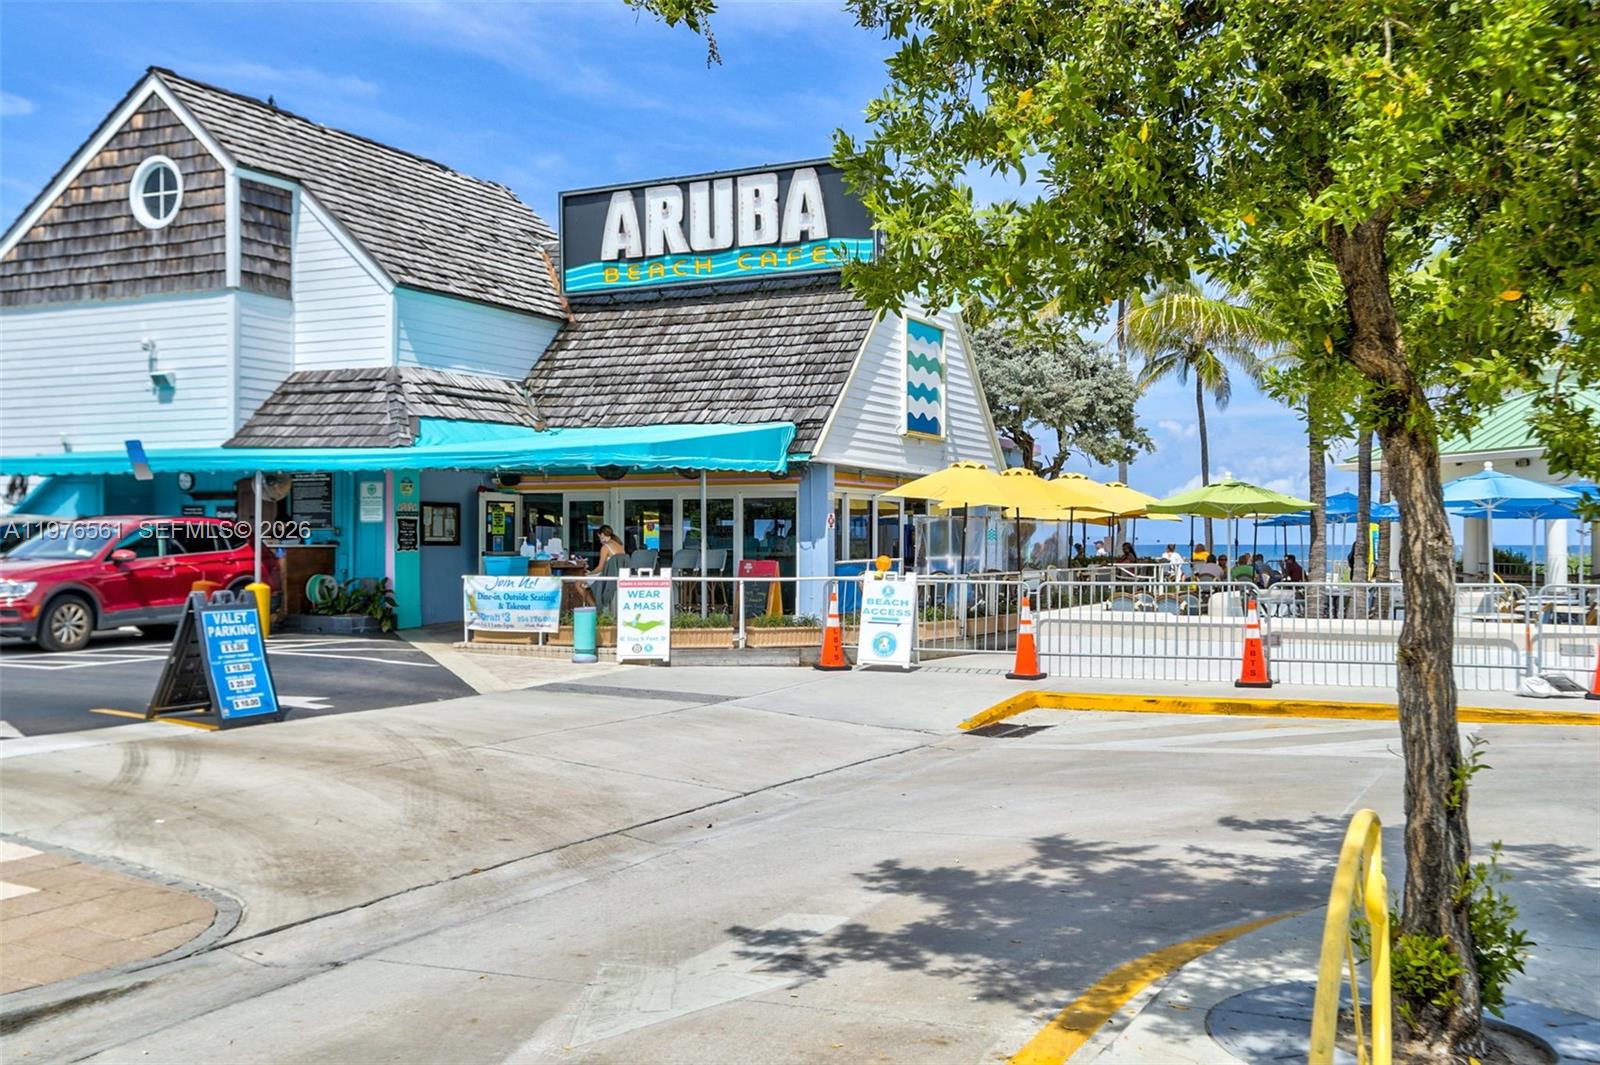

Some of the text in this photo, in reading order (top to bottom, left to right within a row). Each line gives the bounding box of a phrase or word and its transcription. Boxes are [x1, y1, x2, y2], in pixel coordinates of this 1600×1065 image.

[601, 167, 828, 261] ARUBA
[604, 245, 827, 283] BEACH CAFE
[485, 577, 540, 591] Join Us!
[503, 592, 529, 601] Outside
[530, 593, 556, 603] Seating
[627, 590, 661, 598] WEAR
[506, 602, 531, 610] Takeout
[623, 602, 664, 610] A MASK
[866, 598, 909, 607] BEACH
[863, 607, 911, 616] ACCESS
[212, 612, 247, 624] VALET
[207, 624, 256, 637] PARKING
